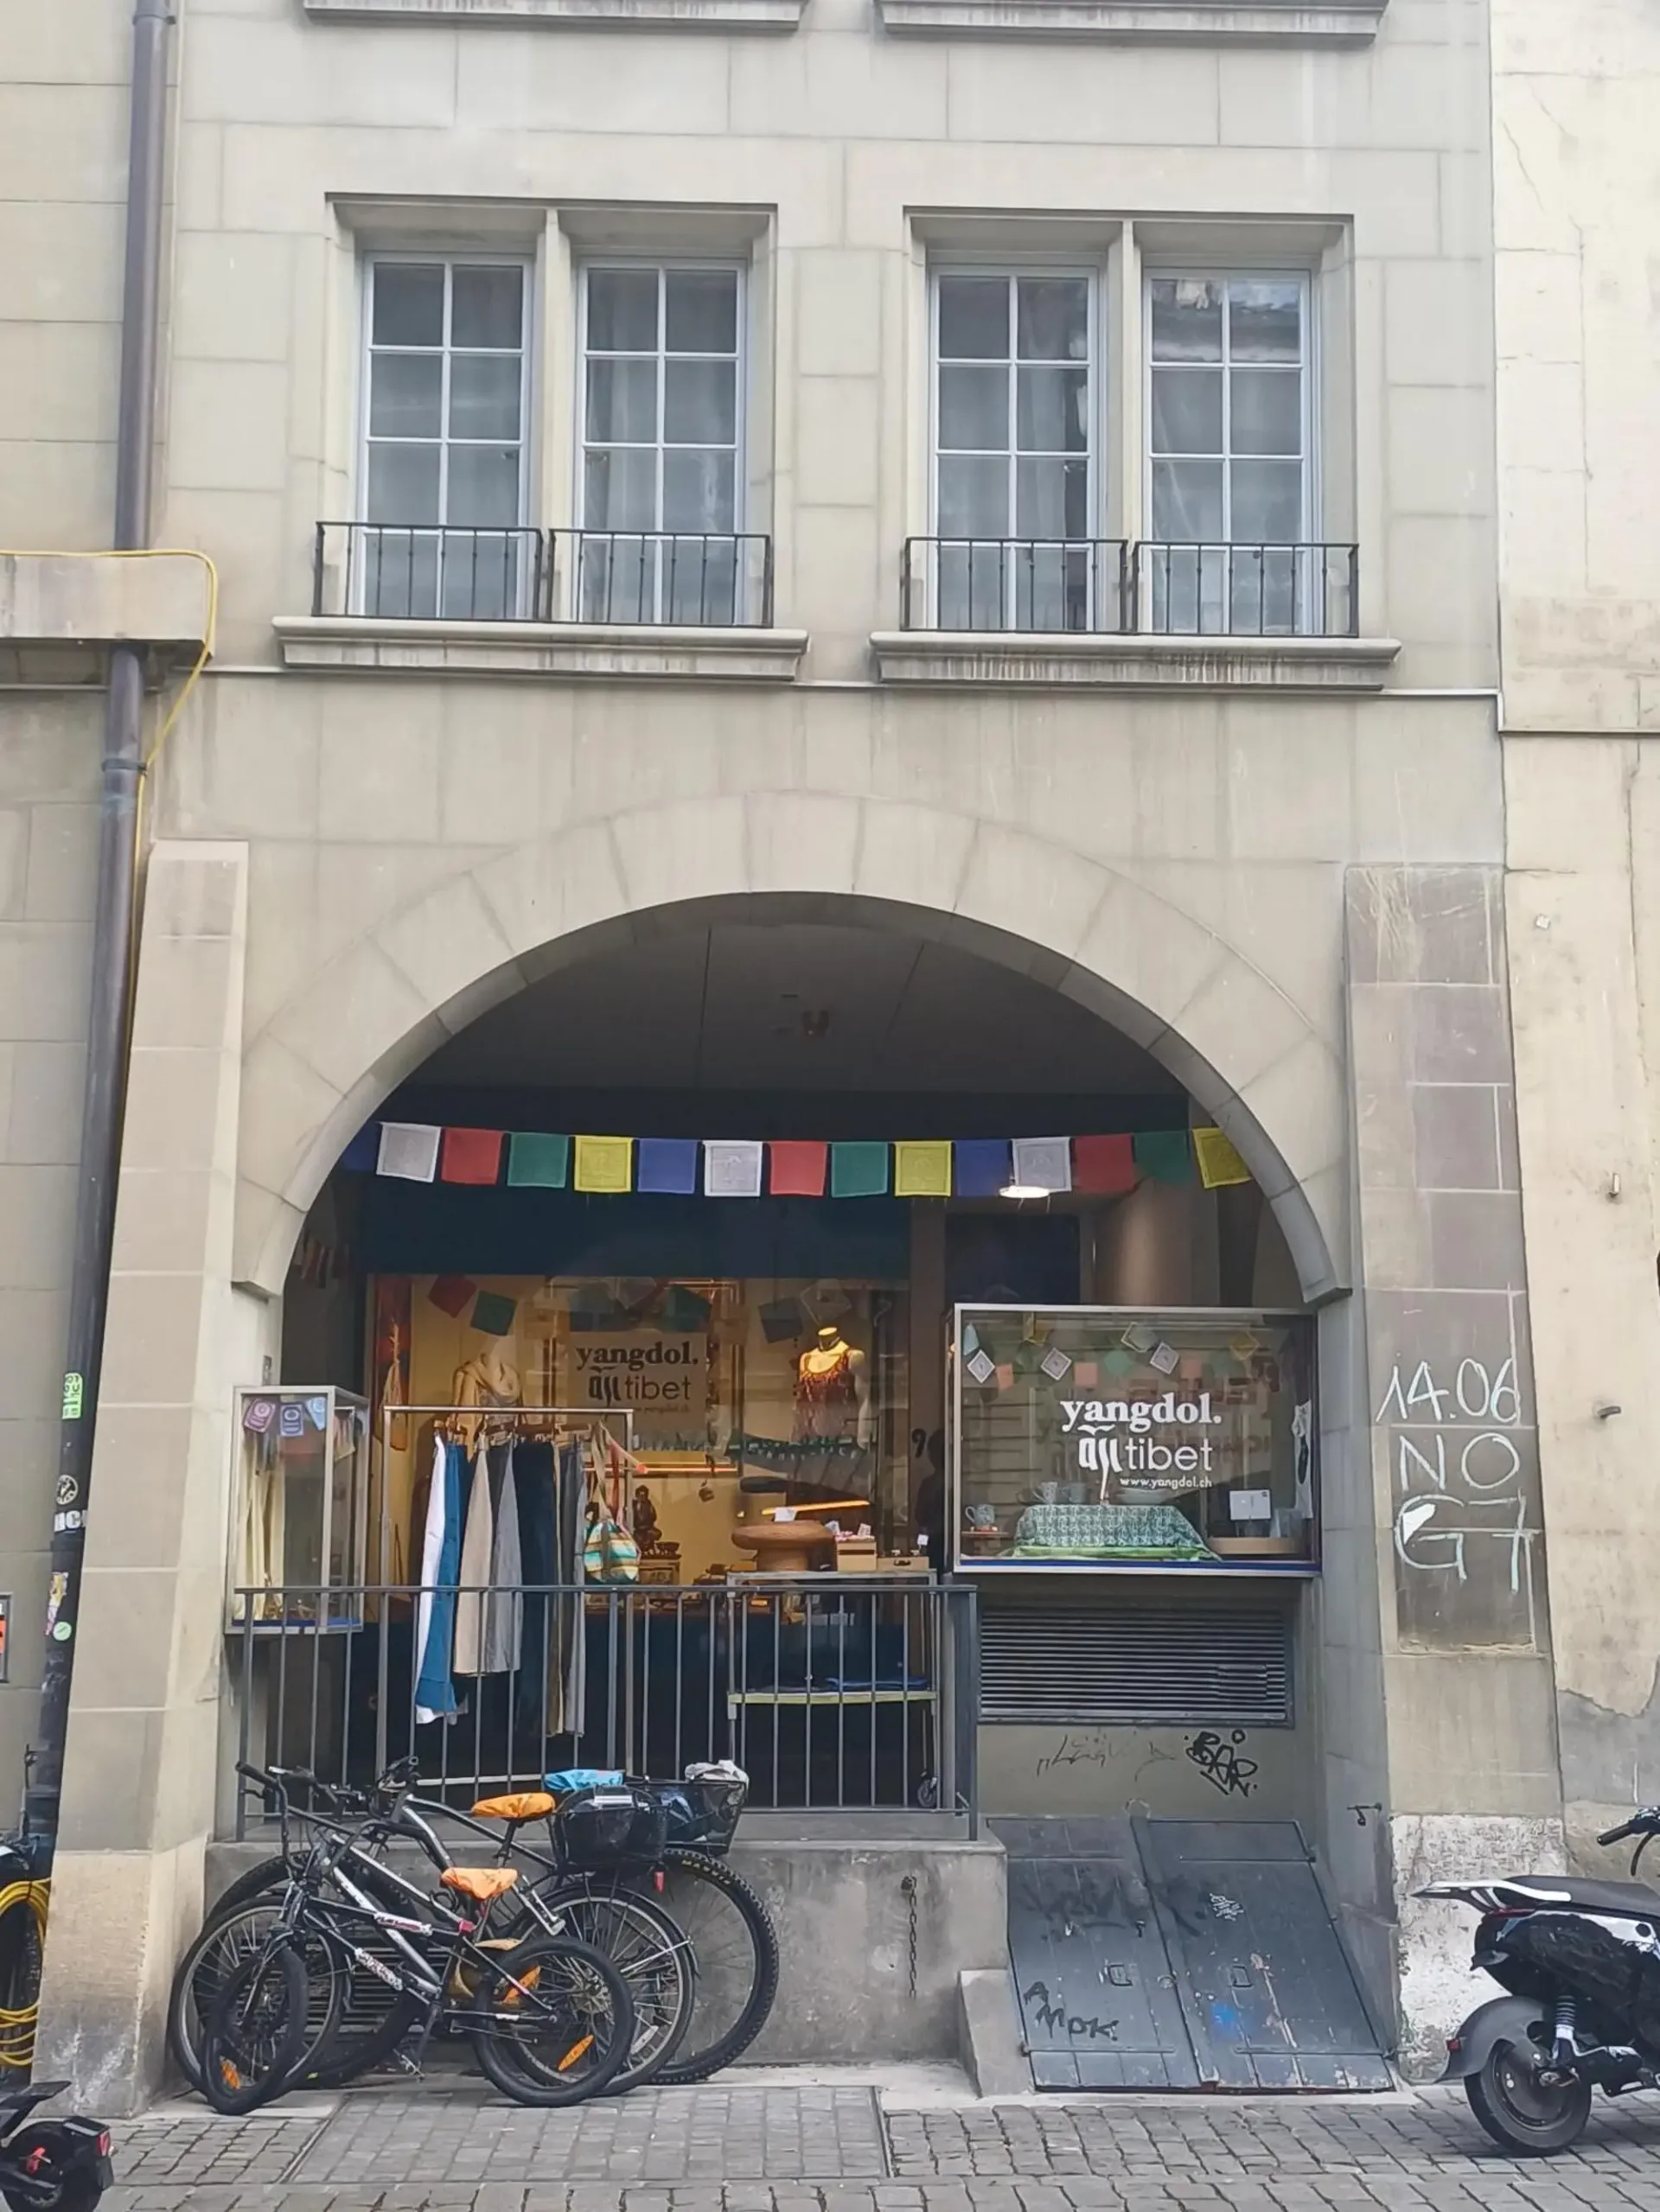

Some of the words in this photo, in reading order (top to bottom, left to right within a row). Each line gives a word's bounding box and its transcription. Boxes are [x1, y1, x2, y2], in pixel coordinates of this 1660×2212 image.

[576, 1340, 699, 1372] yangdol.
[625, 1374, 692, 1400] tibet
[1375, 1357, 1521, 1423] 14.06
[1059, 1393, 1223, 1433] yangdol.
[1125, 1437, 1213, 1471] tibet
[1399, 1432, 1521, 1492] NO
[1119, 1475, 1213, 1490] www.yangdol.ch
[1395, 1488, 1536, 1596] G7
